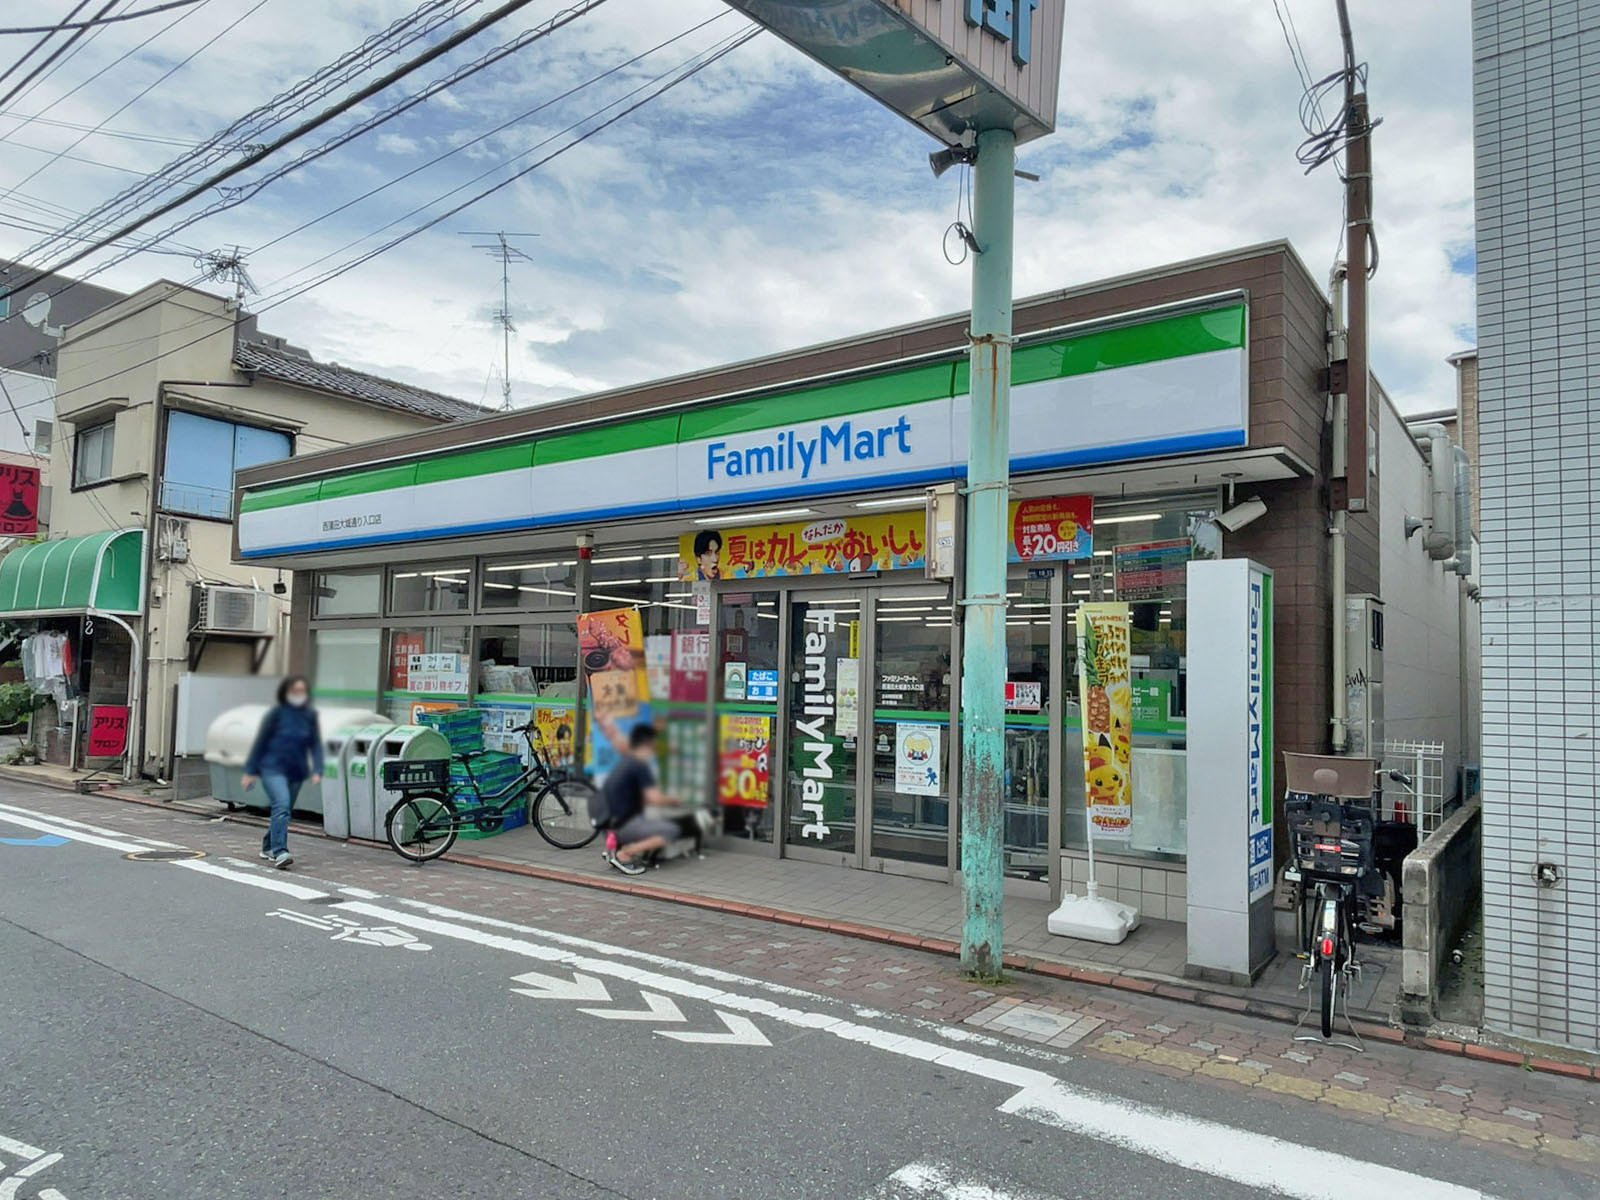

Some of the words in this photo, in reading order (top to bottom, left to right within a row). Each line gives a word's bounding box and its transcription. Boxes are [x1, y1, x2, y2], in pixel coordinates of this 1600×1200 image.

[708, 415, 911, 479] FamilyMart
[0, 466, 35, 486] リス
[803, 522, 844, 541] なんだか
[94, 716, 124, 729] アリス
[796, 609, 835, 840] FamilyMart
[1249, 582, 1261, 825] FamilyMart
